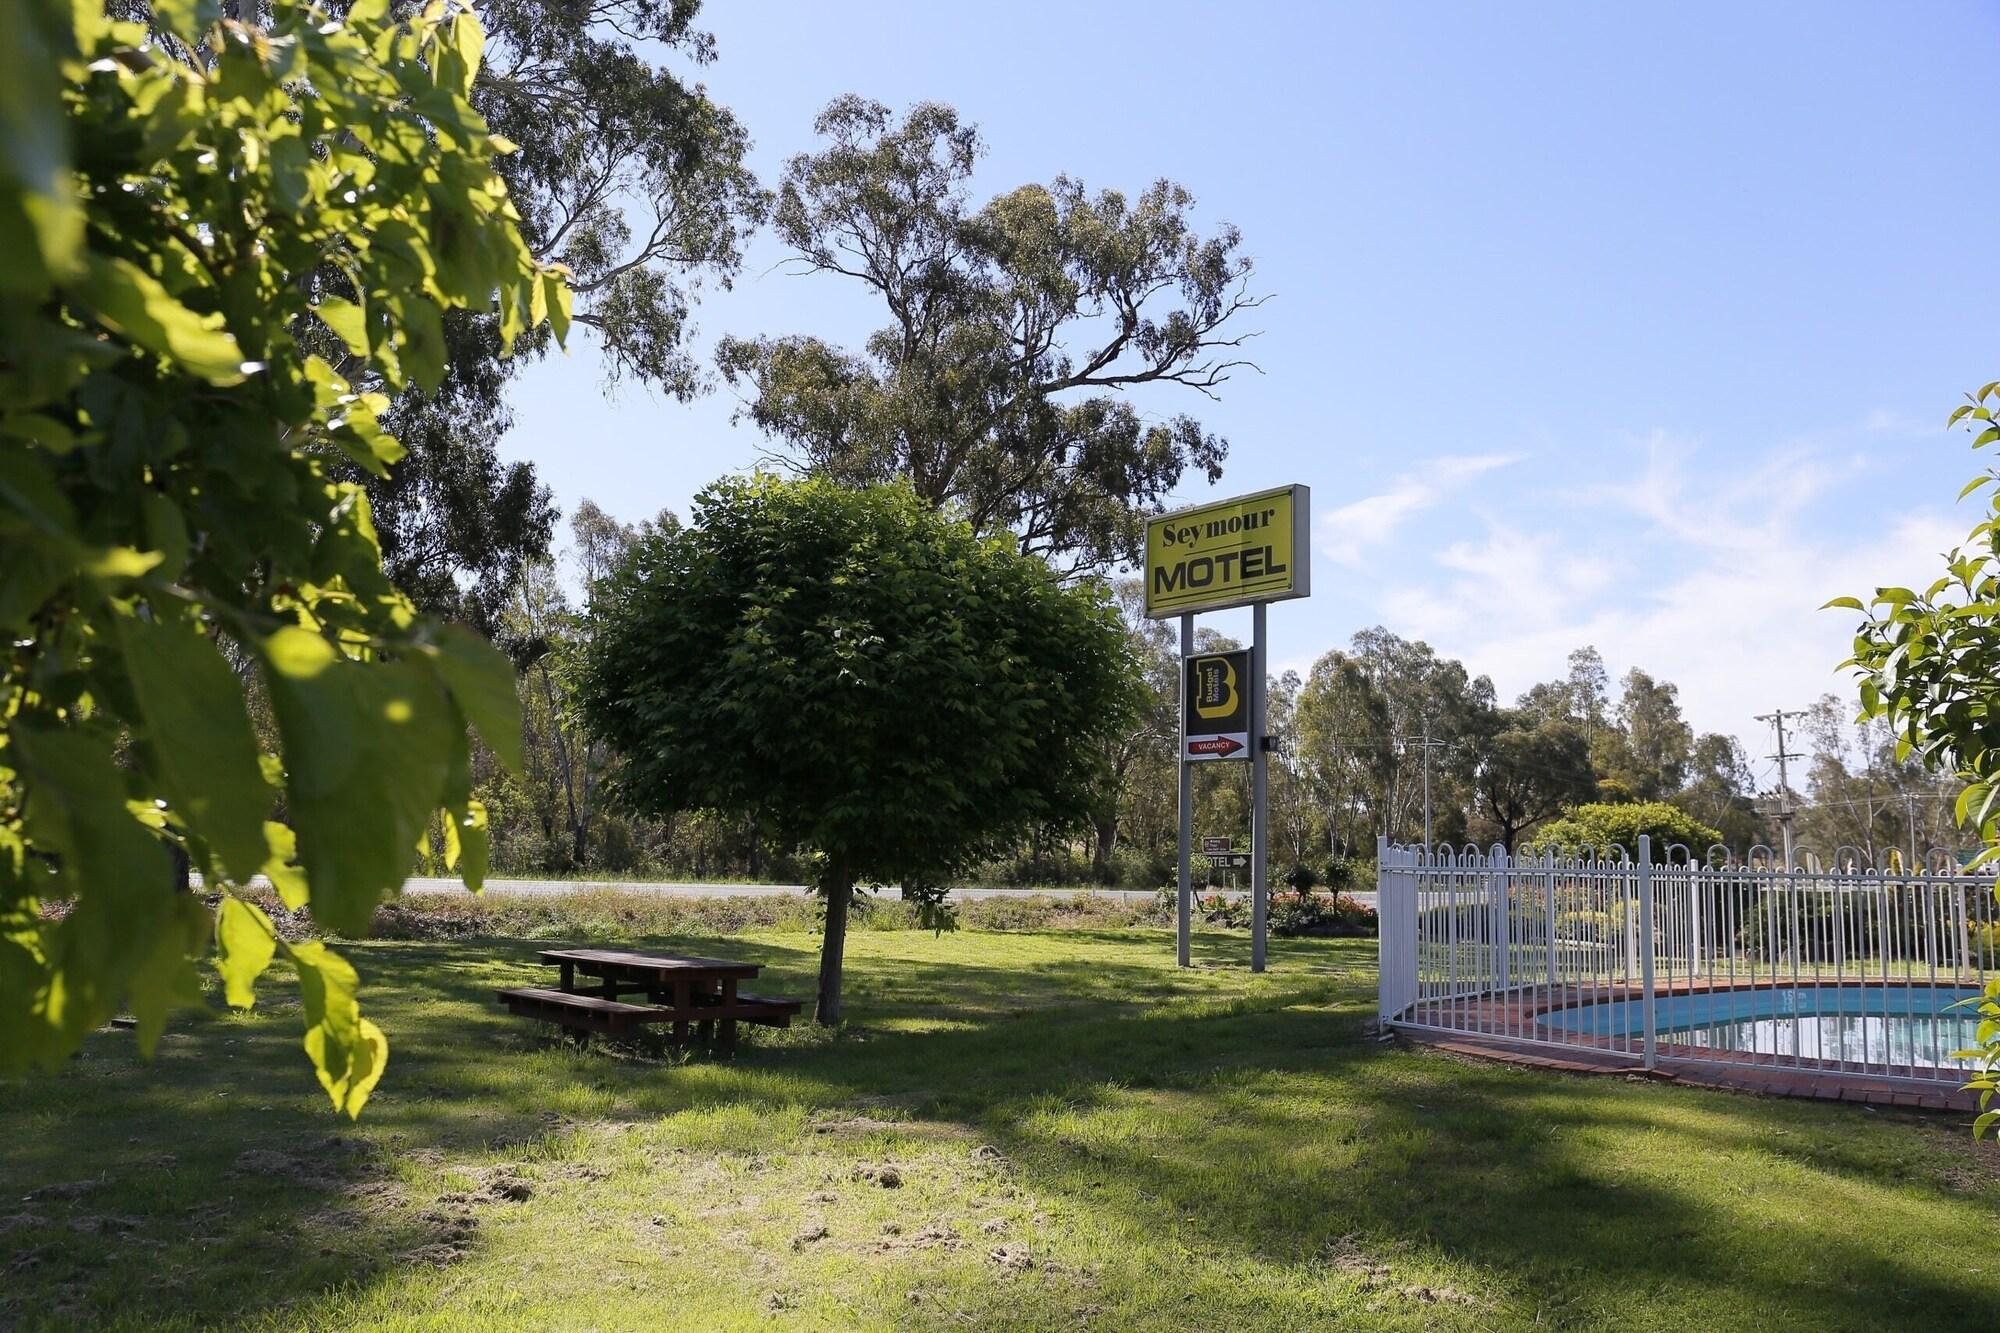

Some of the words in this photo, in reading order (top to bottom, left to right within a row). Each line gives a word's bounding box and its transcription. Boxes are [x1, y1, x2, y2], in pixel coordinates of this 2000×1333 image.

[1162, 508, 1275, 548] Seymour
[1154, 546, 1285, 594] MOTEL
[1198, 741, 1230, 750] VACANCY
[1206, 856, 1230, 867] OTEL
